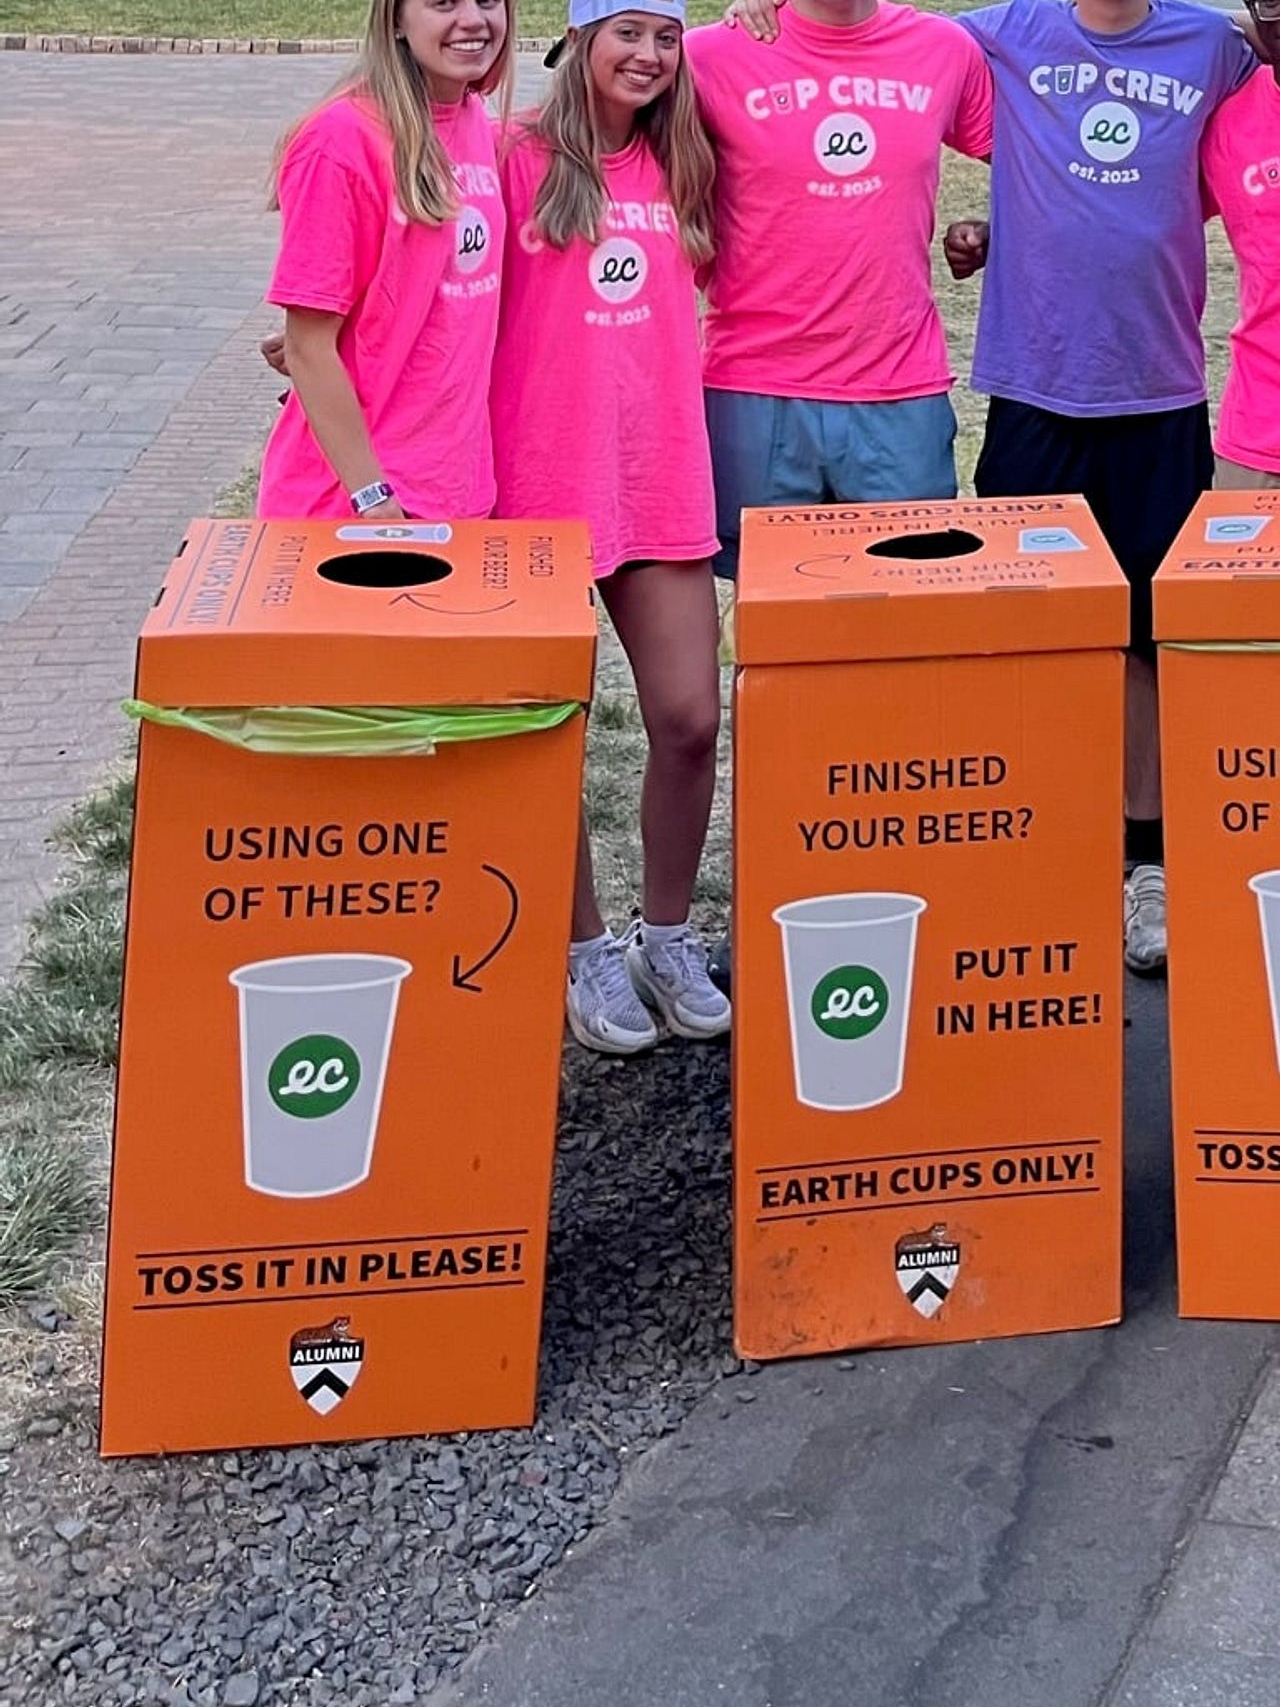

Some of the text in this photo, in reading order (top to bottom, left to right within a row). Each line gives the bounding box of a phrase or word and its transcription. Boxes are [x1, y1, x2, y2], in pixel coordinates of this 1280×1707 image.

[828, 74, 933, 114] CREW
[1105, 68, 1203, 116] CREW
[823, 131, 868, 157] ec
[1087, 119, 1131, 144] ec
[842, 175, 882, 198] 2023
[1100, 168, 1140, 184] 2023
[458, 224, 486, 255] ec
[599, 257, 639, 283] ec
[827, 755, 1007, 796] FINISHED
[798, 806, 1034, 852] YOUR BEER?
[1221, 802, 1270, 834] OF
[204, 821, 449, 862] USING ONE
[204, 878, 442, 922] OF THESE?
[954, 942, 1079, 980] PUT IT
[820, 984, 880, 1021] ec
[936, 994, 1102, 1036] IN HERE!
[278, 1057, 350, 1096] ec
[760, 1152, 1096, 1209] EARTH CUPS ONLY!
[138, 1243, 523, 1297] TOSS IT IN PLEASE!
[898, 1248, 958, 1269] ALUMNI
[292, 1344, 362, 1364] ALUMNI
